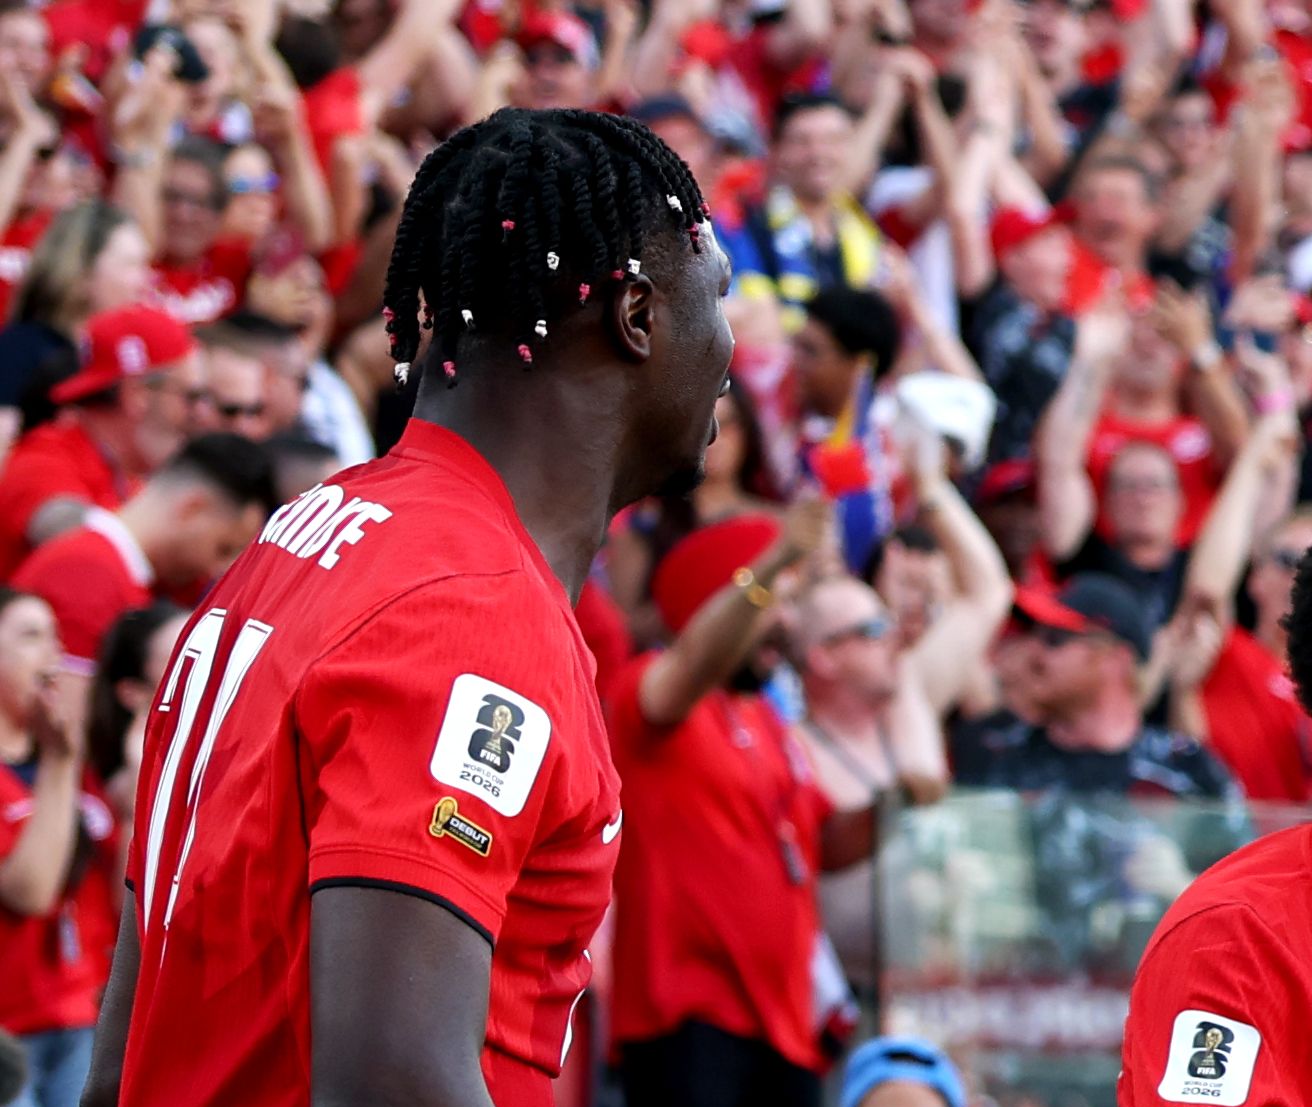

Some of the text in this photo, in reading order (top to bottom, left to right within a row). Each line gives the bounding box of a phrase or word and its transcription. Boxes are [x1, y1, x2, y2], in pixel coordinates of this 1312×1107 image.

[479, 748, 501, 767] FIFA
[459, 769, 501, 799] 2026
[449, 816, 489, 845] DEBUT
[1196, 1066, 1217, 1075] FIFA
[1181, 1087, 1222, 1097] 2026
